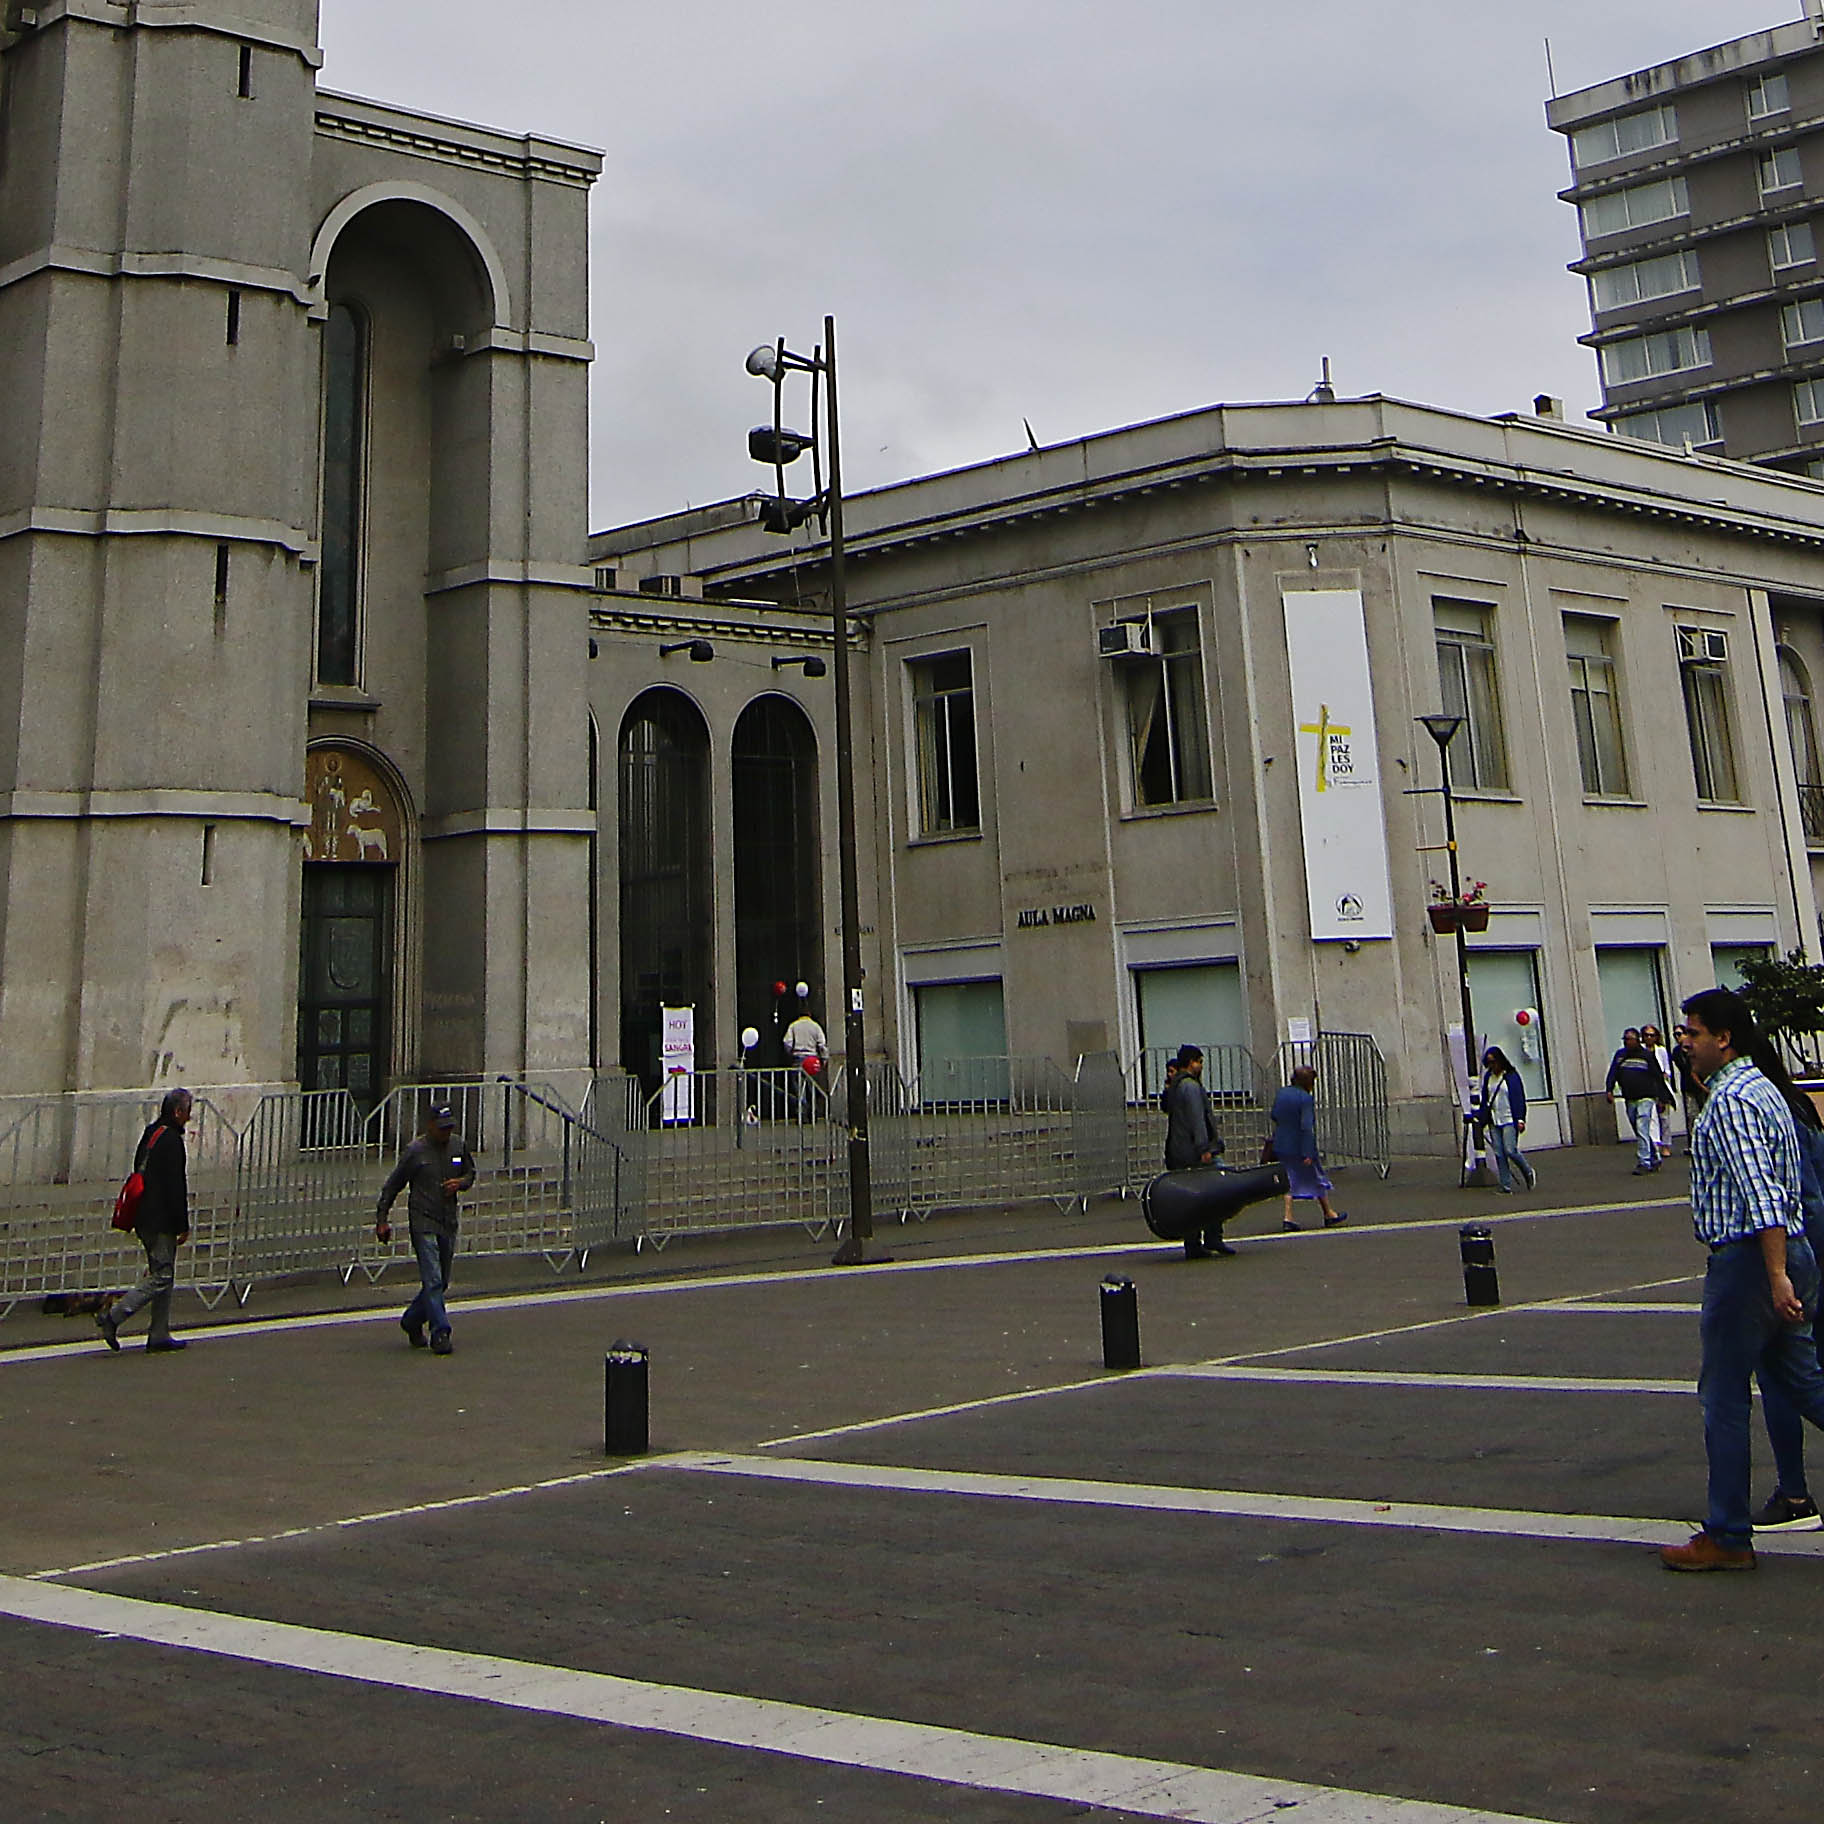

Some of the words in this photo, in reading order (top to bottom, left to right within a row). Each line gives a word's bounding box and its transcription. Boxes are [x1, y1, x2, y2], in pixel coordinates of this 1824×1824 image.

[1329, 735, 1343, 744] MI
[1330, 744, 1351, 754] PAZ
[1331, 754, 1351, 764] LES
[1332, 764, 1354, 774] DOY
[1017, 909, 1049, 929] AULA
[1052, 903, 1097, 924] MAGNA
